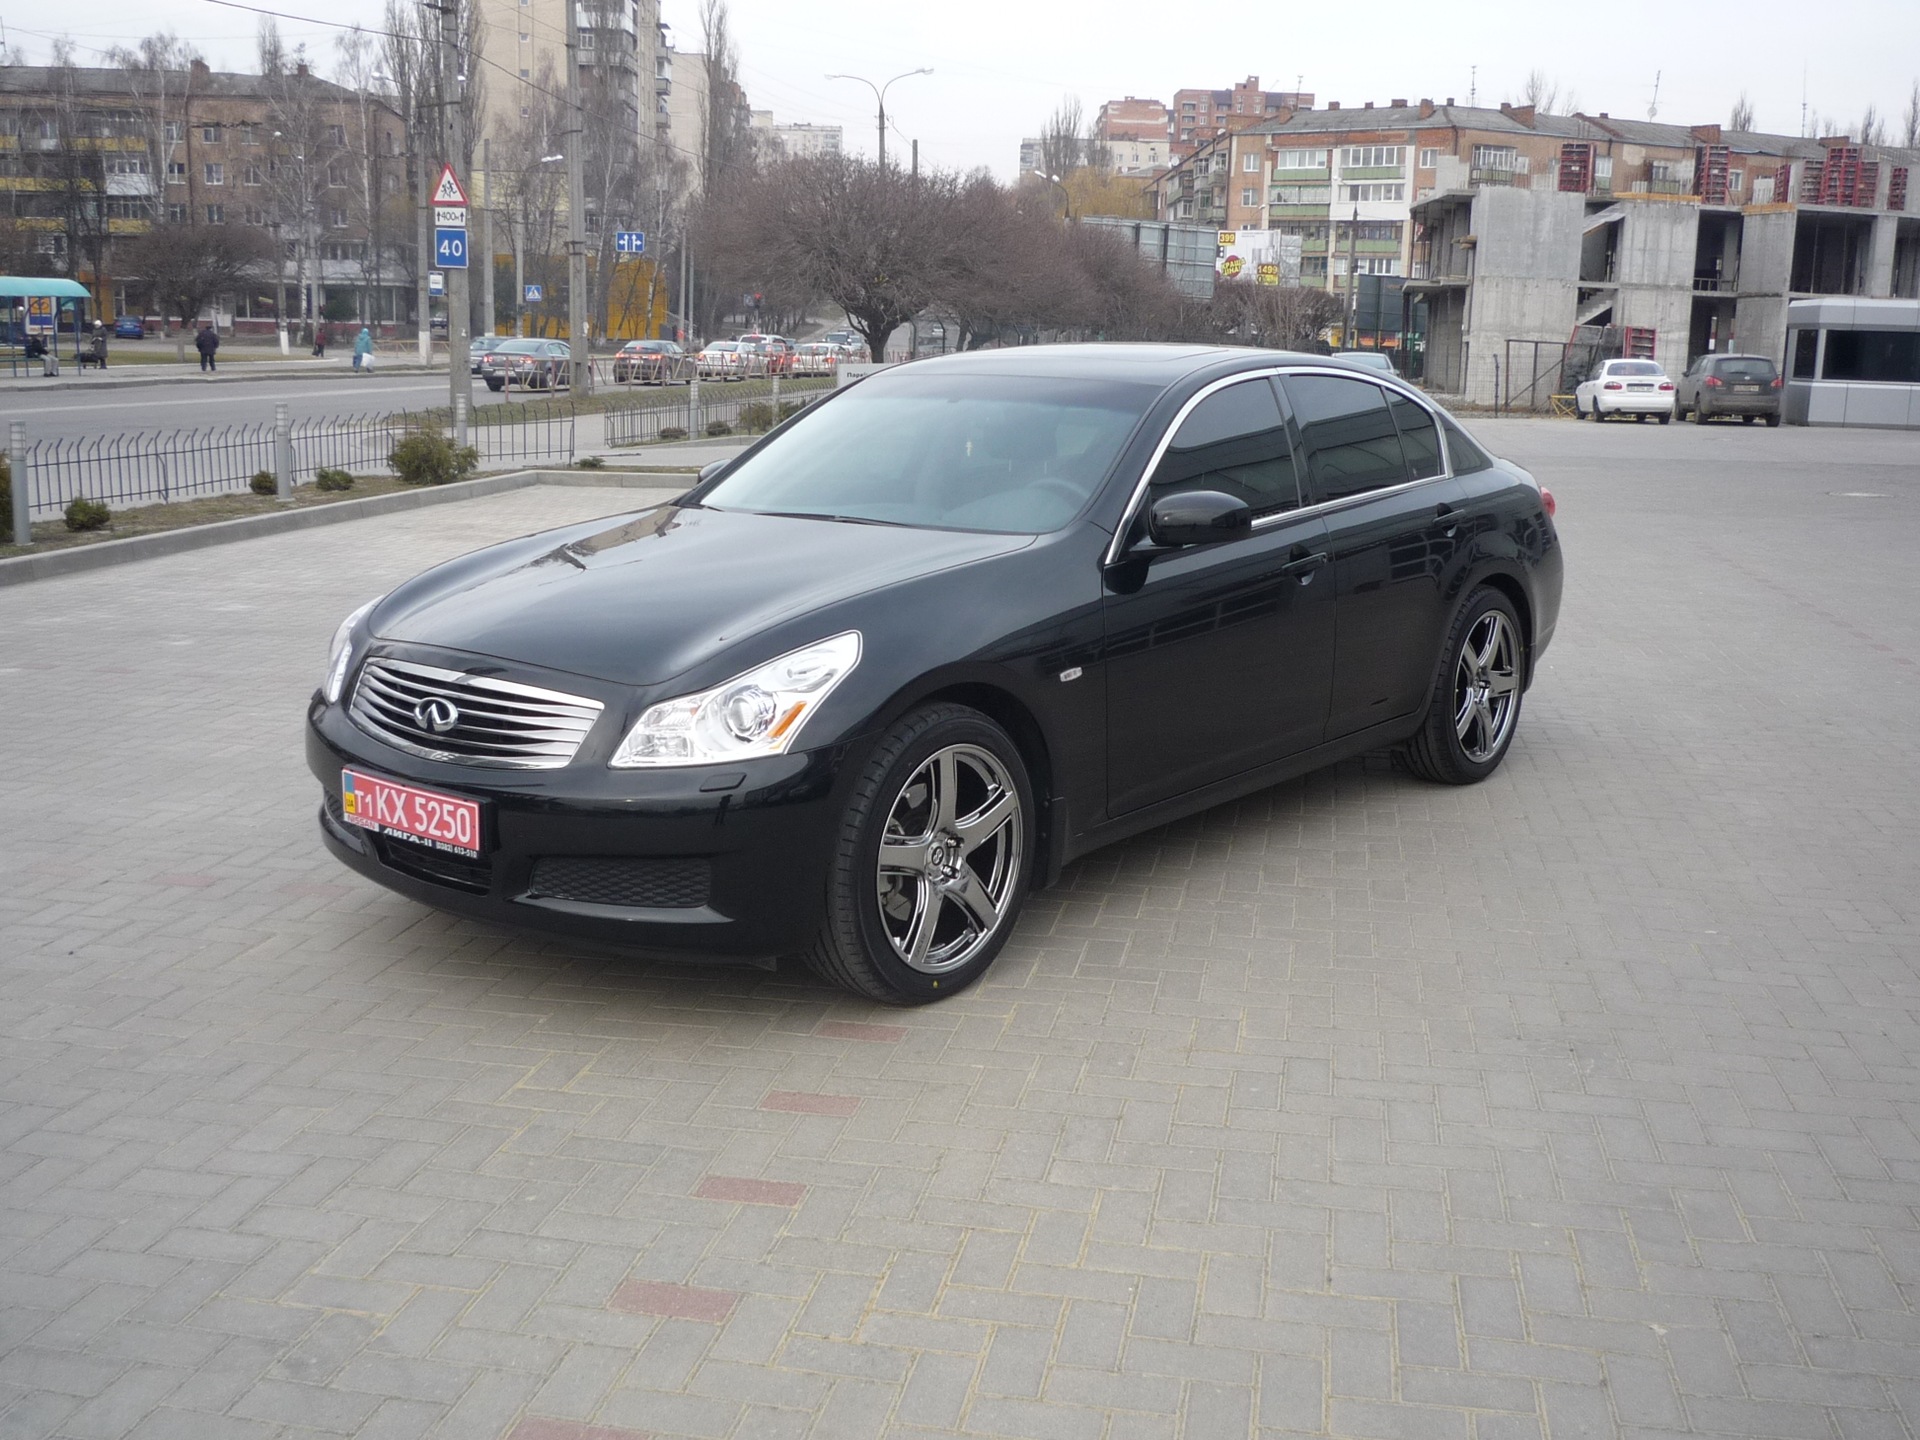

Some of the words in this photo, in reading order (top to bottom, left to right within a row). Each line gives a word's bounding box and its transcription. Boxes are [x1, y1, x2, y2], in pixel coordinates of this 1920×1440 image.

[1219, 234, 1235, 243] 399
[439, 239, 462, 257] 40
[1257, 264, 1278, 274] 1499
[347, 814, 376, 830] NISSAN
[414, 796, 471, 843] 5250
